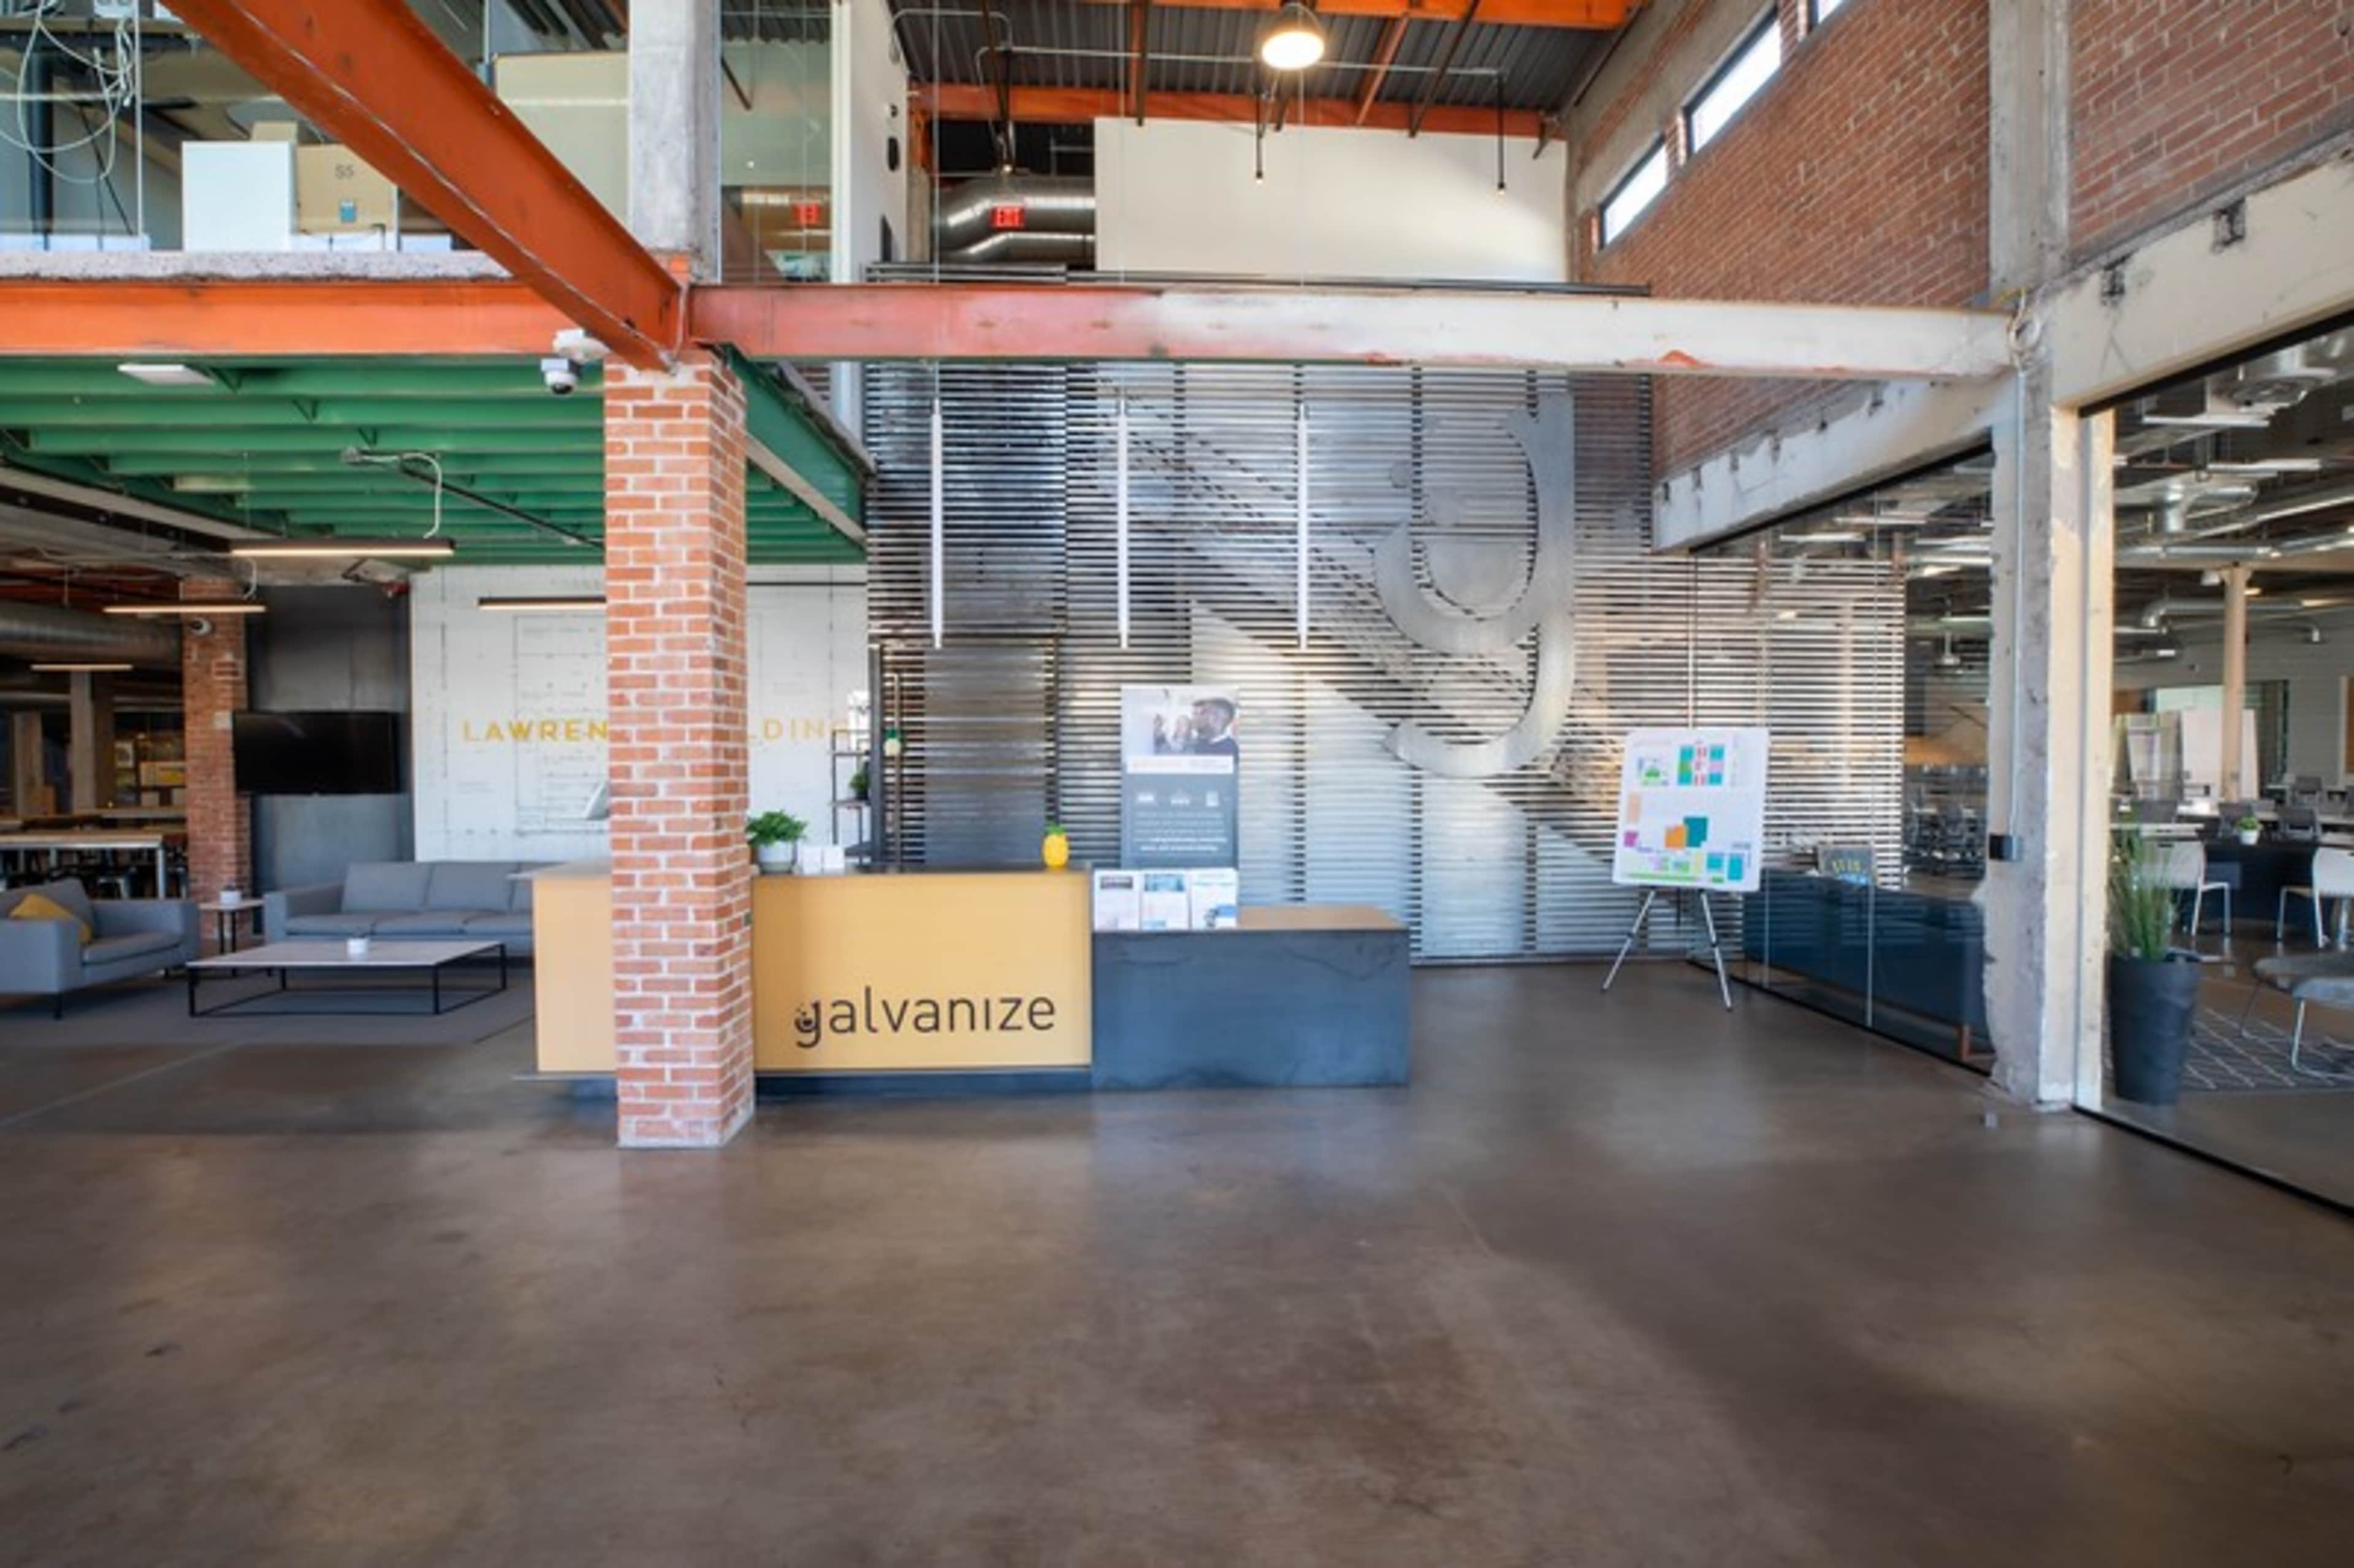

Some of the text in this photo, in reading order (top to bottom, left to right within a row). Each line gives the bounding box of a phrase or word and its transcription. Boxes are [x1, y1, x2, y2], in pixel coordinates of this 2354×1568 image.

[996, 207, 1019, 227] EXIT
[463, 719, 608, 741] LAWREN
[794, 986, 1056, 1049] galvanize
